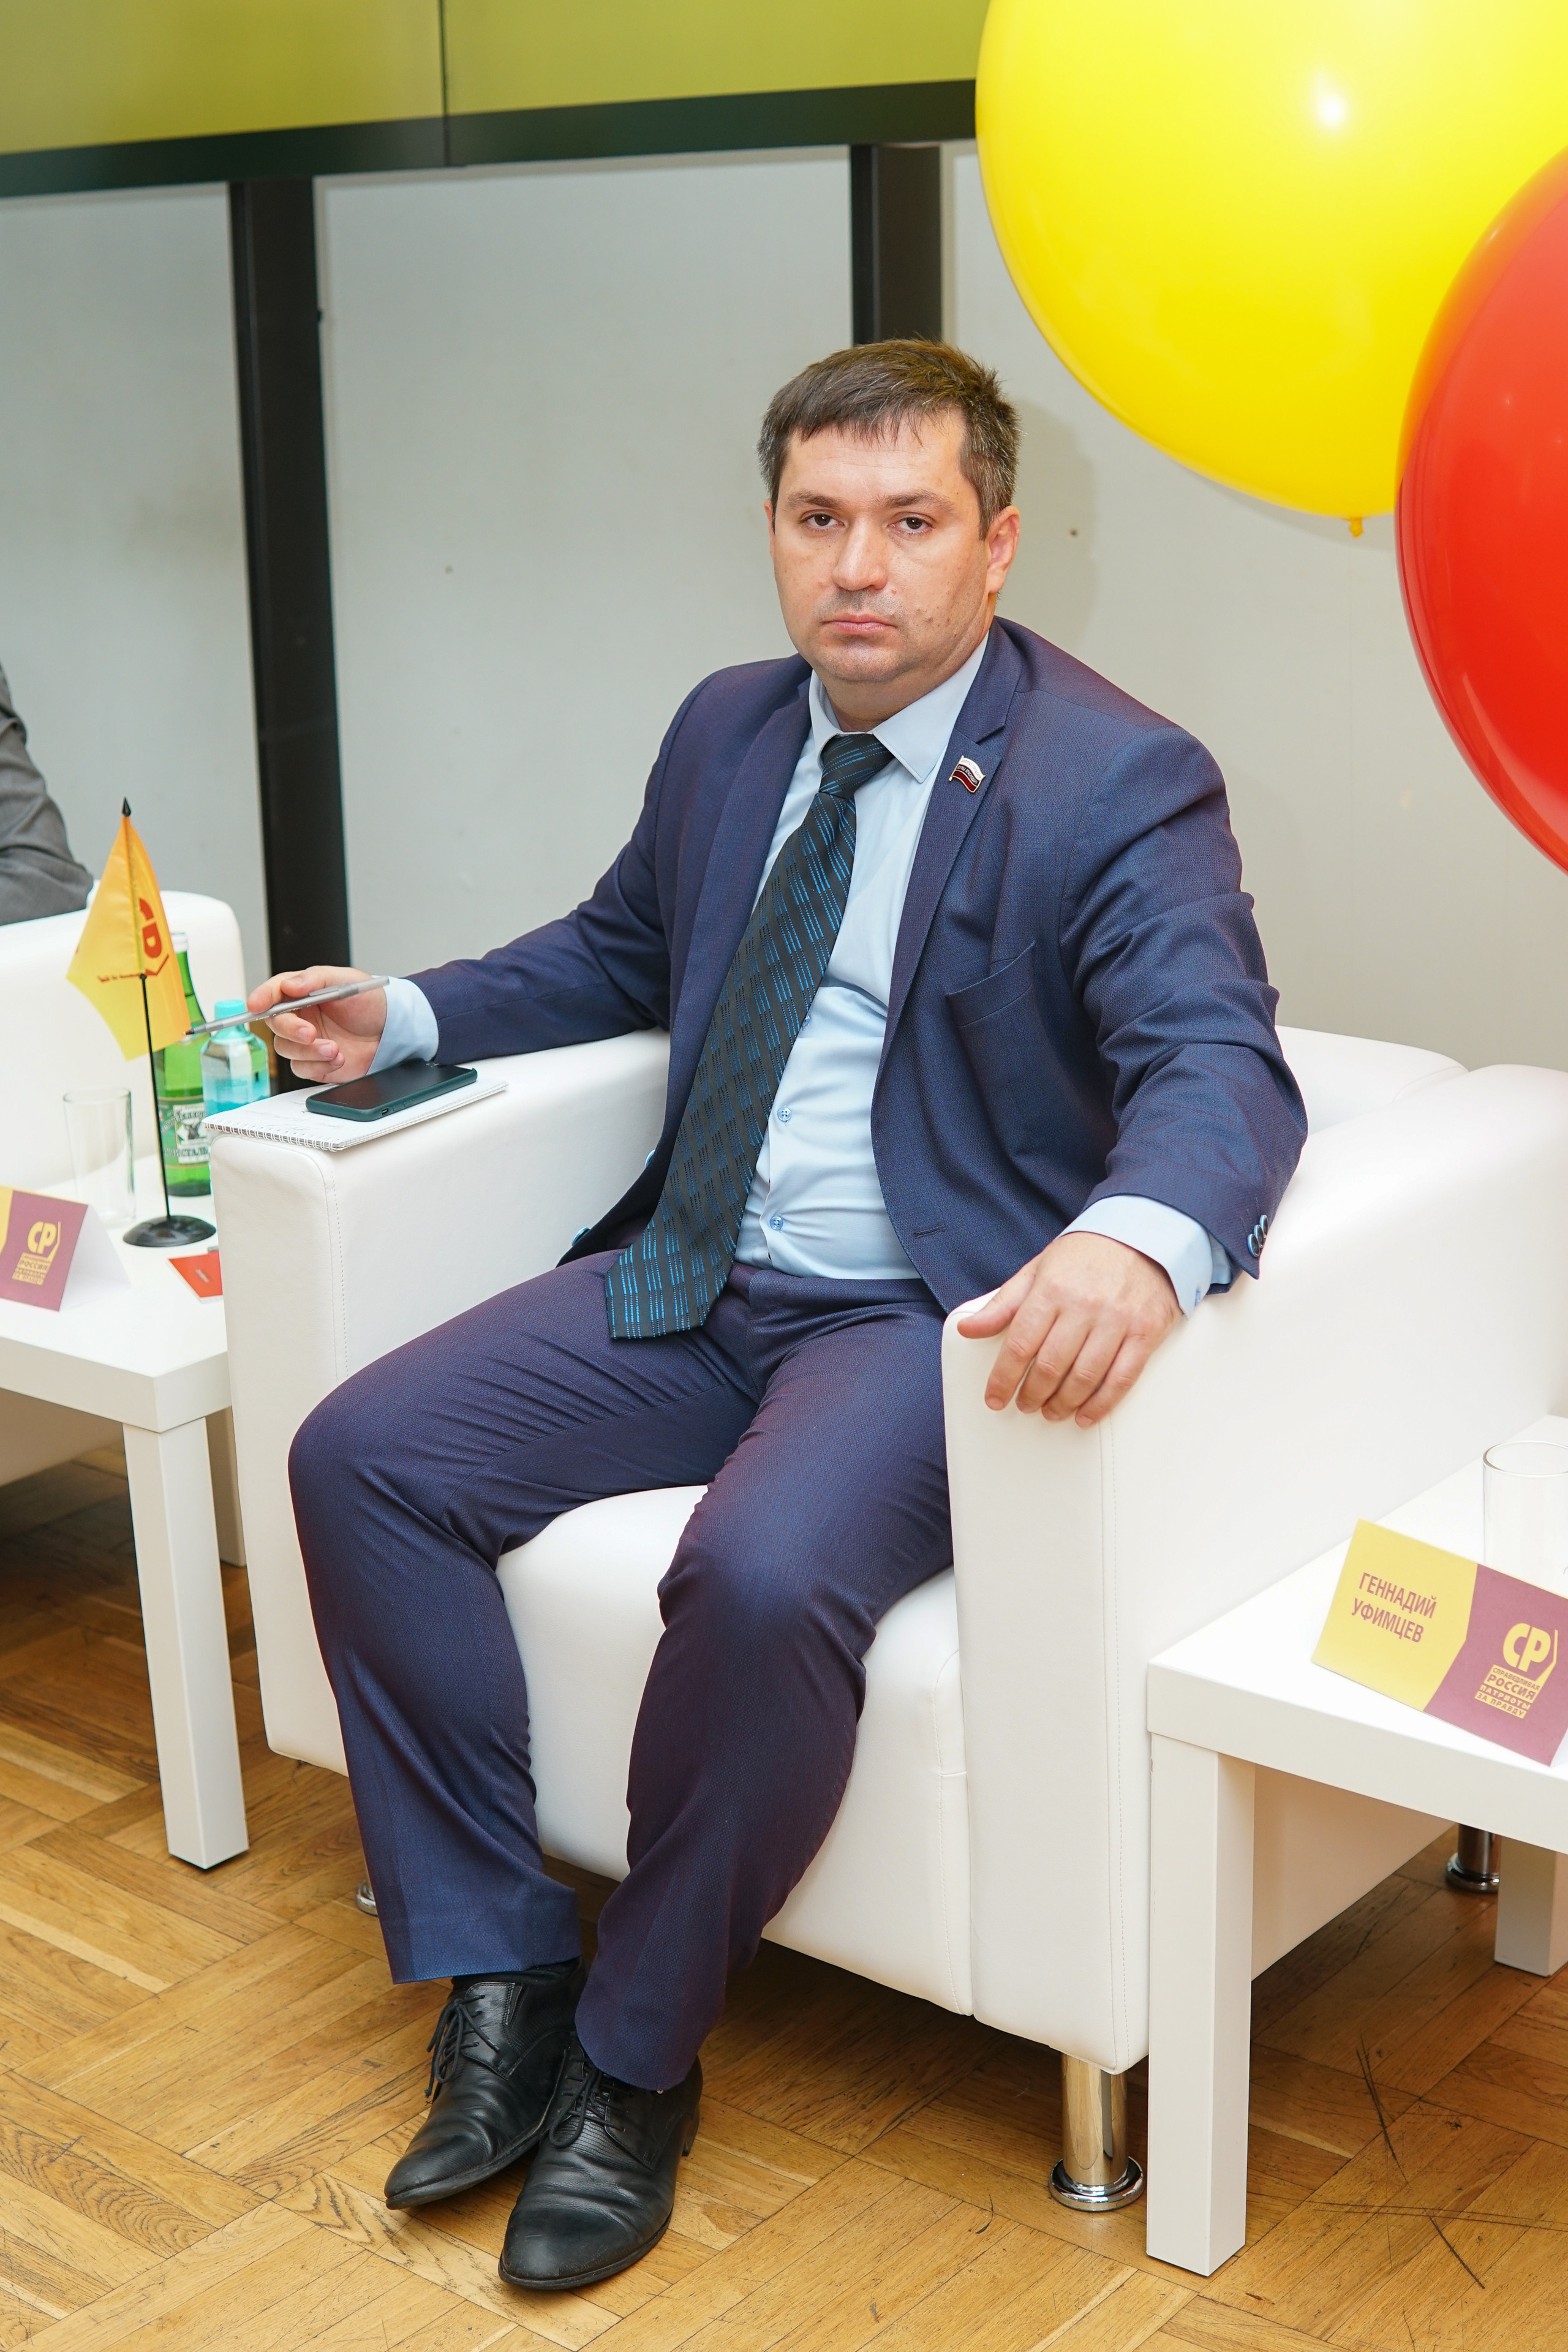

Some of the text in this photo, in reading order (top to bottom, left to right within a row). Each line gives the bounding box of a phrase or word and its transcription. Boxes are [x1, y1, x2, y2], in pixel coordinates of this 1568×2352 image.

[27, 1221, 58, 1254] СР
[1359, 1572, 1437, 1619] ГЕННАДИЙ
[1351, 1598, 1424, 1643] УФИМЦЕВ
[1503, 1623, 1551, 1672] СР
[1487, 1673, 1536, 1700] РОССИЯ
[1493, 1667, 1540, 1691] СПРАВЕДЛИВАЯ
[1477, 1692, 1525, 1716] ЗА ПРАВДУ
[1480, 1684, 1531, 1710] ПАТРИОТЫ
